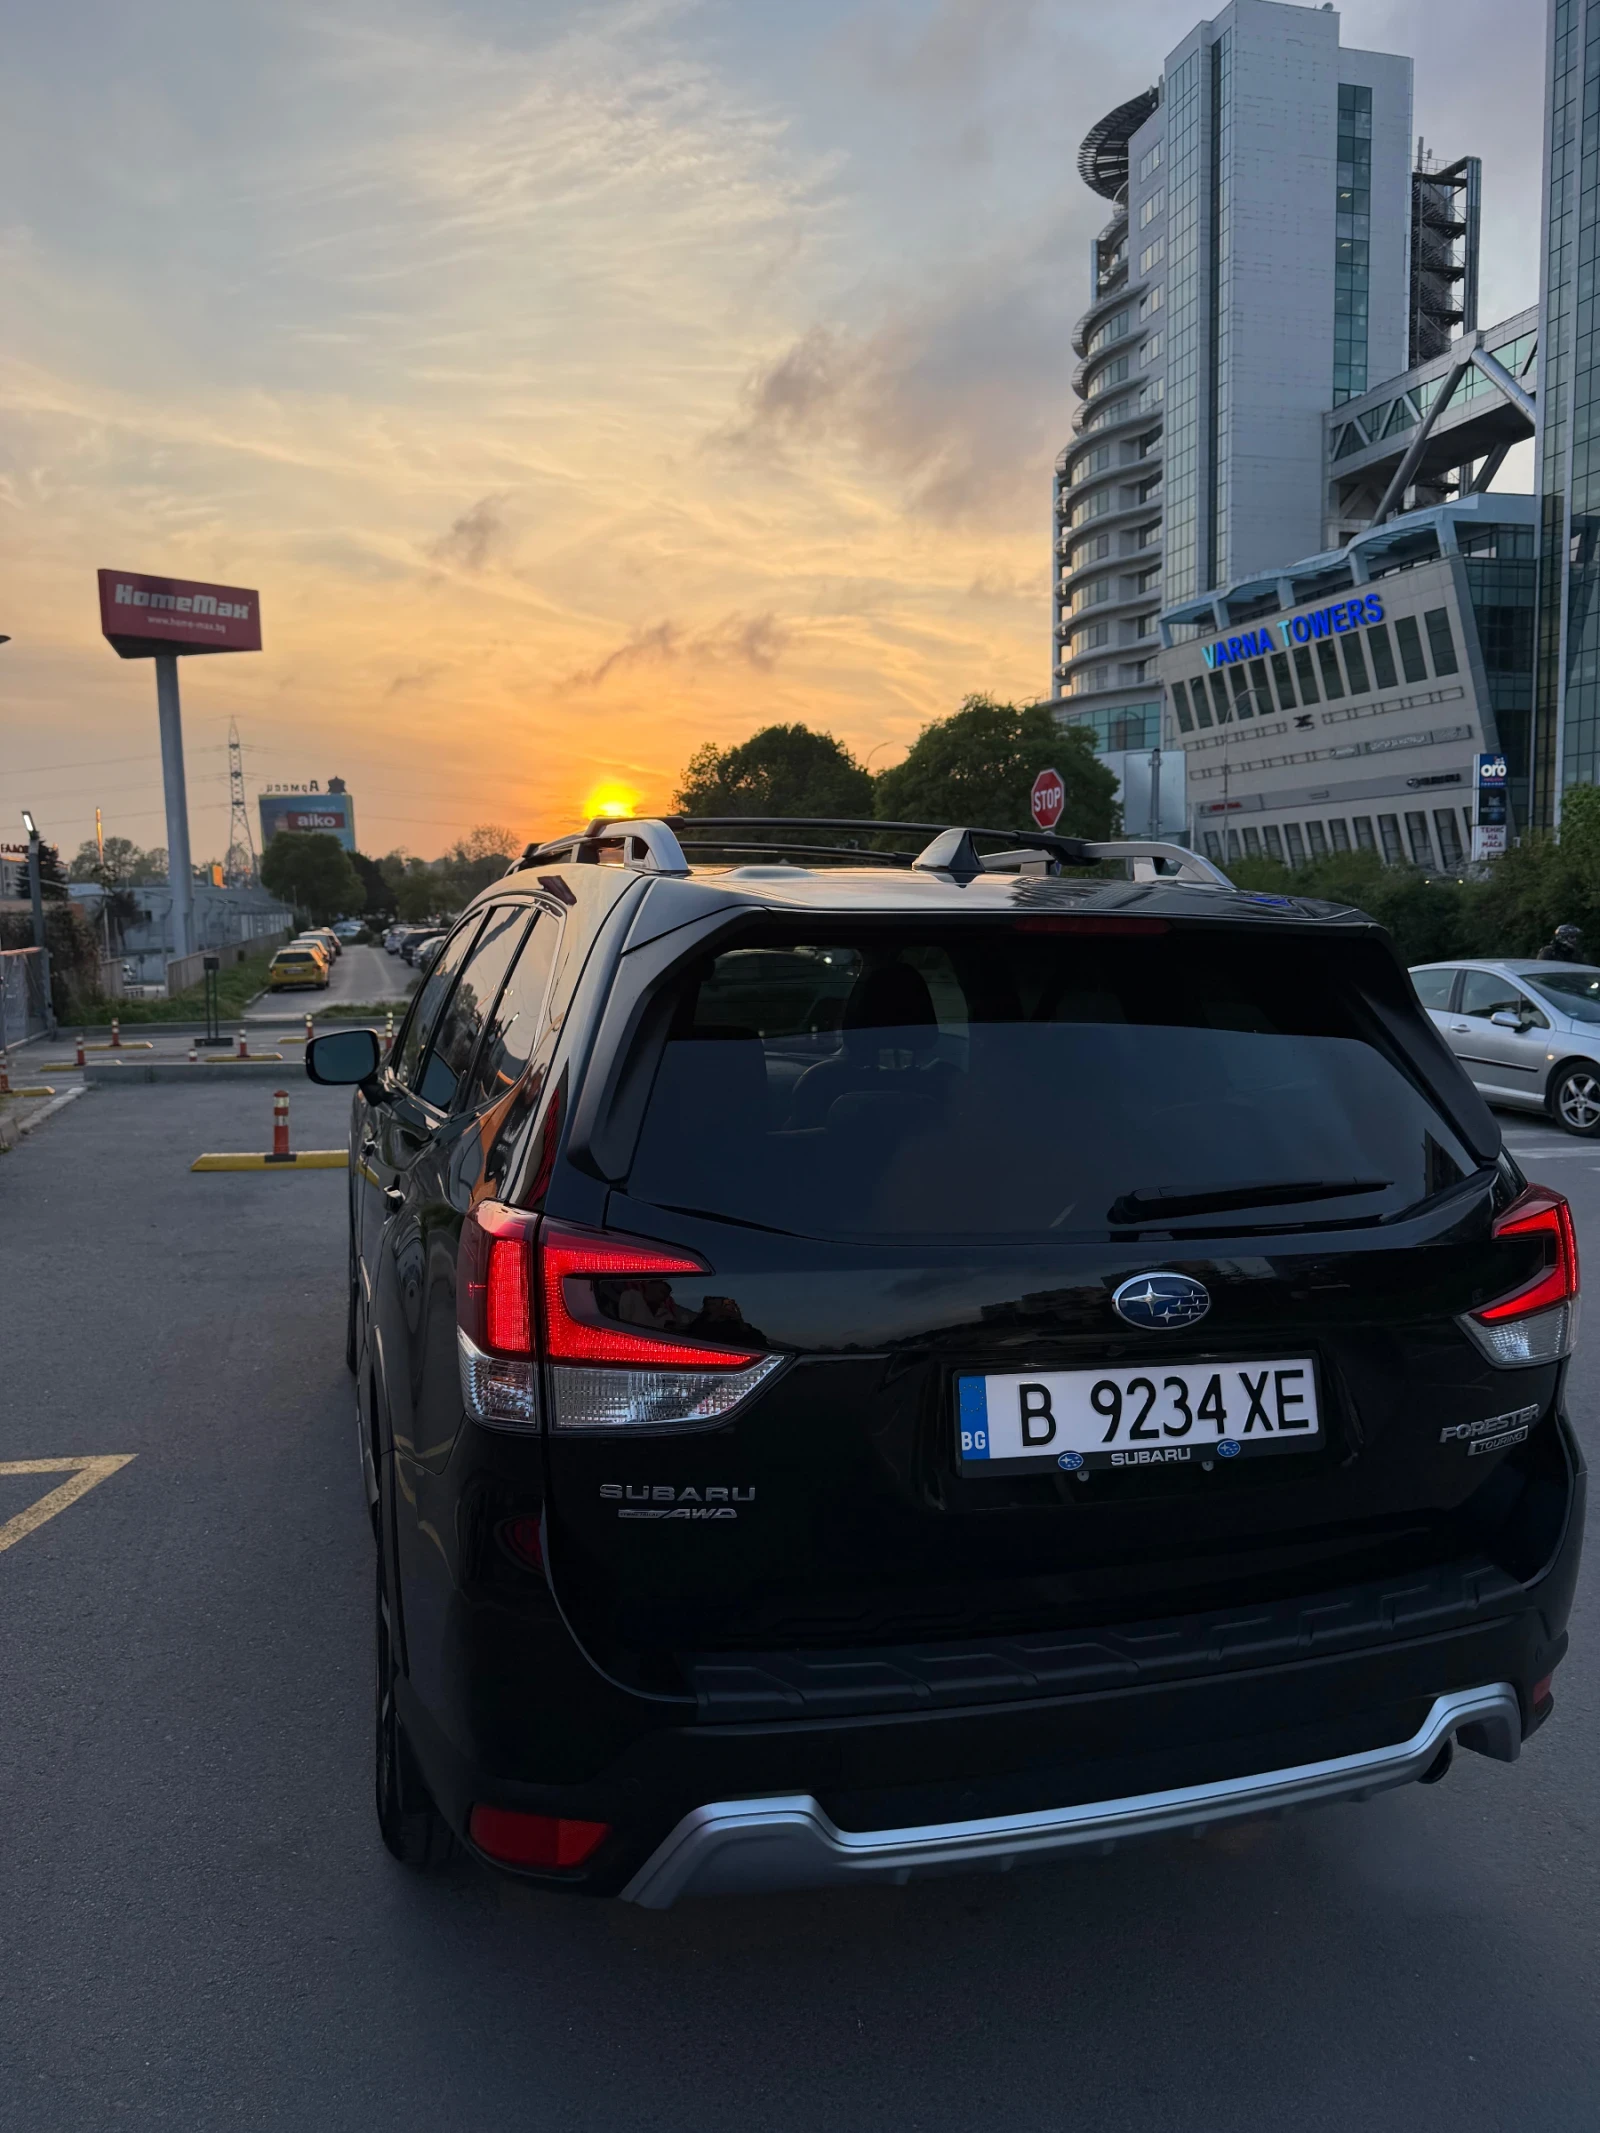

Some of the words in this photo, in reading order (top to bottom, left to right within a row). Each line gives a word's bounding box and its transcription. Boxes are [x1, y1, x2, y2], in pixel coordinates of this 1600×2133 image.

[115, 583, 249, 619] HomeMax
[1202, 628, 1275, 669] VARNA
[1277, 594, 1385, 647] TOWERS
[1034, 787, 1061, 812] STOP
[297, 813, 336, 827] aiko
[1017, 1383, 1057, 1447] B
[1089, 1372, 1228, 1444] 9234
[1237, 1369, 1310, 1434] XE
[1440, 1403, 1540, 1443] FORESTER
[961, 1430, 987, 1450] BG
[1480, 1431, 1523, 1451] TOURING
[1110, 1448, 1191, 1467] SUBARU
[599, 1484, 756, 1502] SUBARU
[662, 1508, 738, 1519] AWD
